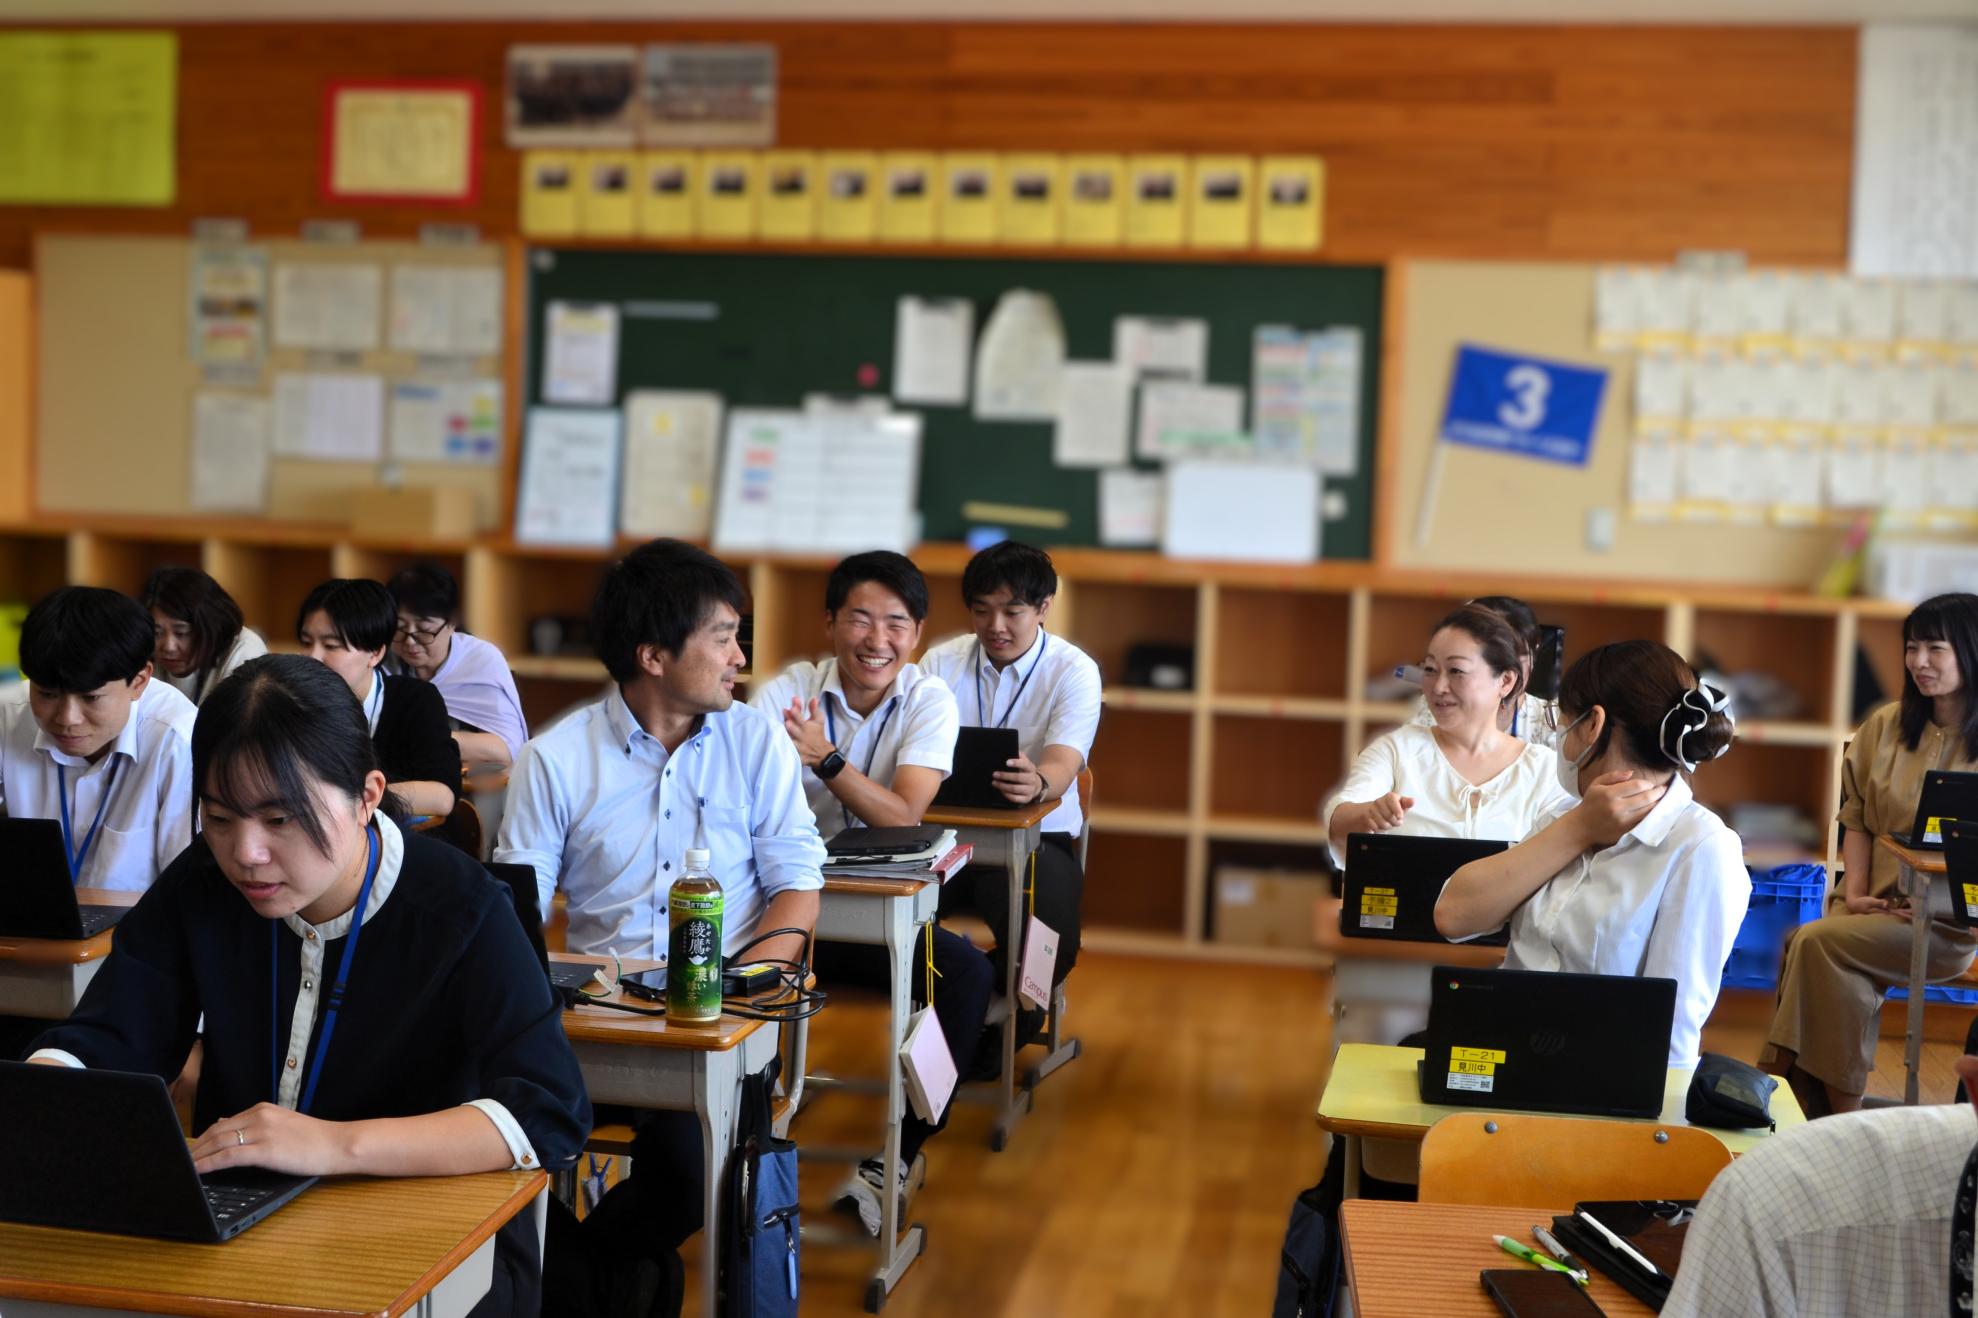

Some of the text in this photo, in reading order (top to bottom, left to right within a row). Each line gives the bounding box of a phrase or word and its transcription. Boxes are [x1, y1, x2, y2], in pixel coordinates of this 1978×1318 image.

[1497, 365, 1553, 430] 3
[688, 921, 706, 954] 綾鷹
[1024, 976, 1048, 1002] Campus
